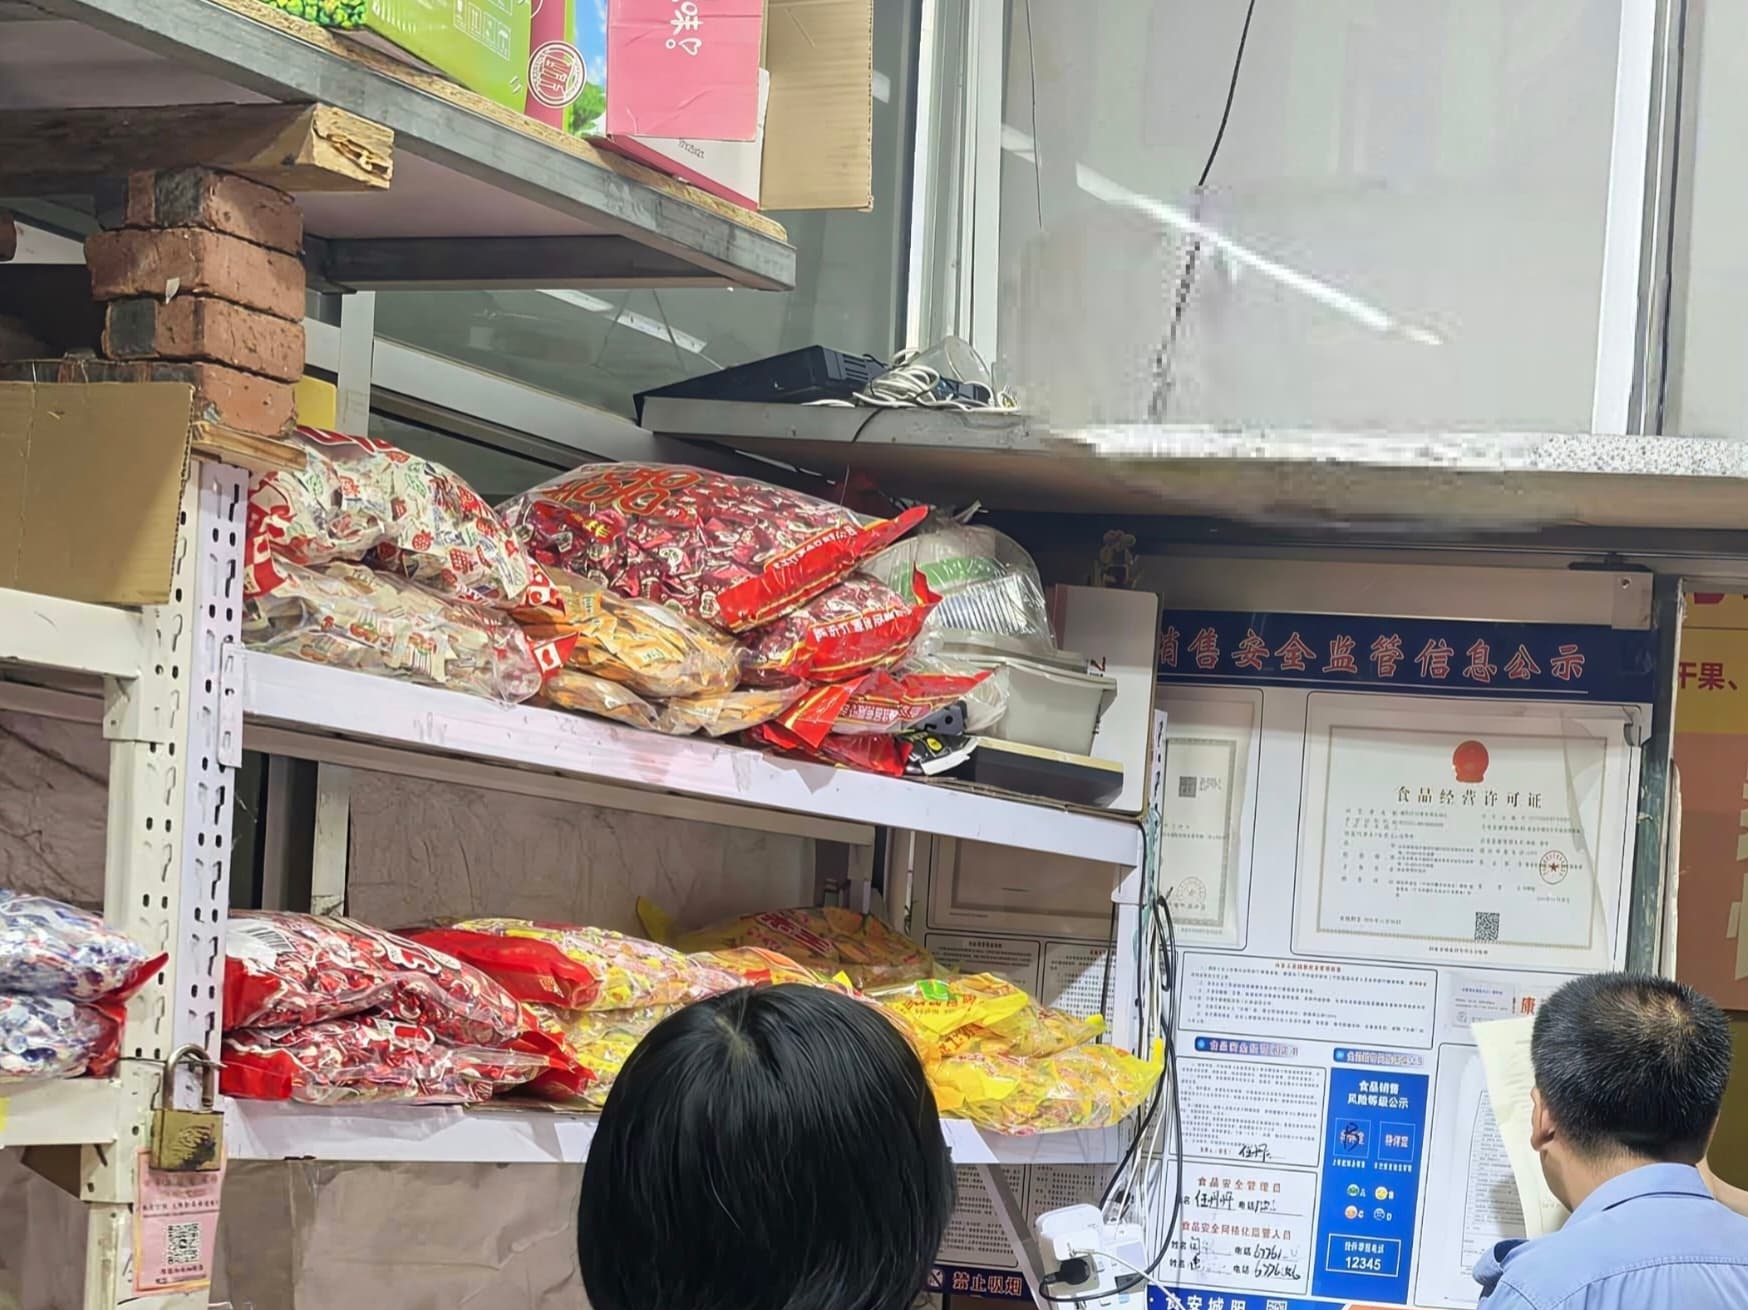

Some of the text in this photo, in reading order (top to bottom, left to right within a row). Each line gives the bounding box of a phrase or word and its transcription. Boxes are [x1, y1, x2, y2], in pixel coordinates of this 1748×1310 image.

[1398, 785, 1543, 810] 食品经营许可证
[1358, 1079, 1400, 1096] 食品销售
[1347, 1093, 1409, 1109] 风险等级公示
[1198, 1176, 1281, 1193] 食品安全管理员
[1345, 1256, 1382, 1271] 12345
[952, 1271, 1023, 1296] 禁止吸烟
